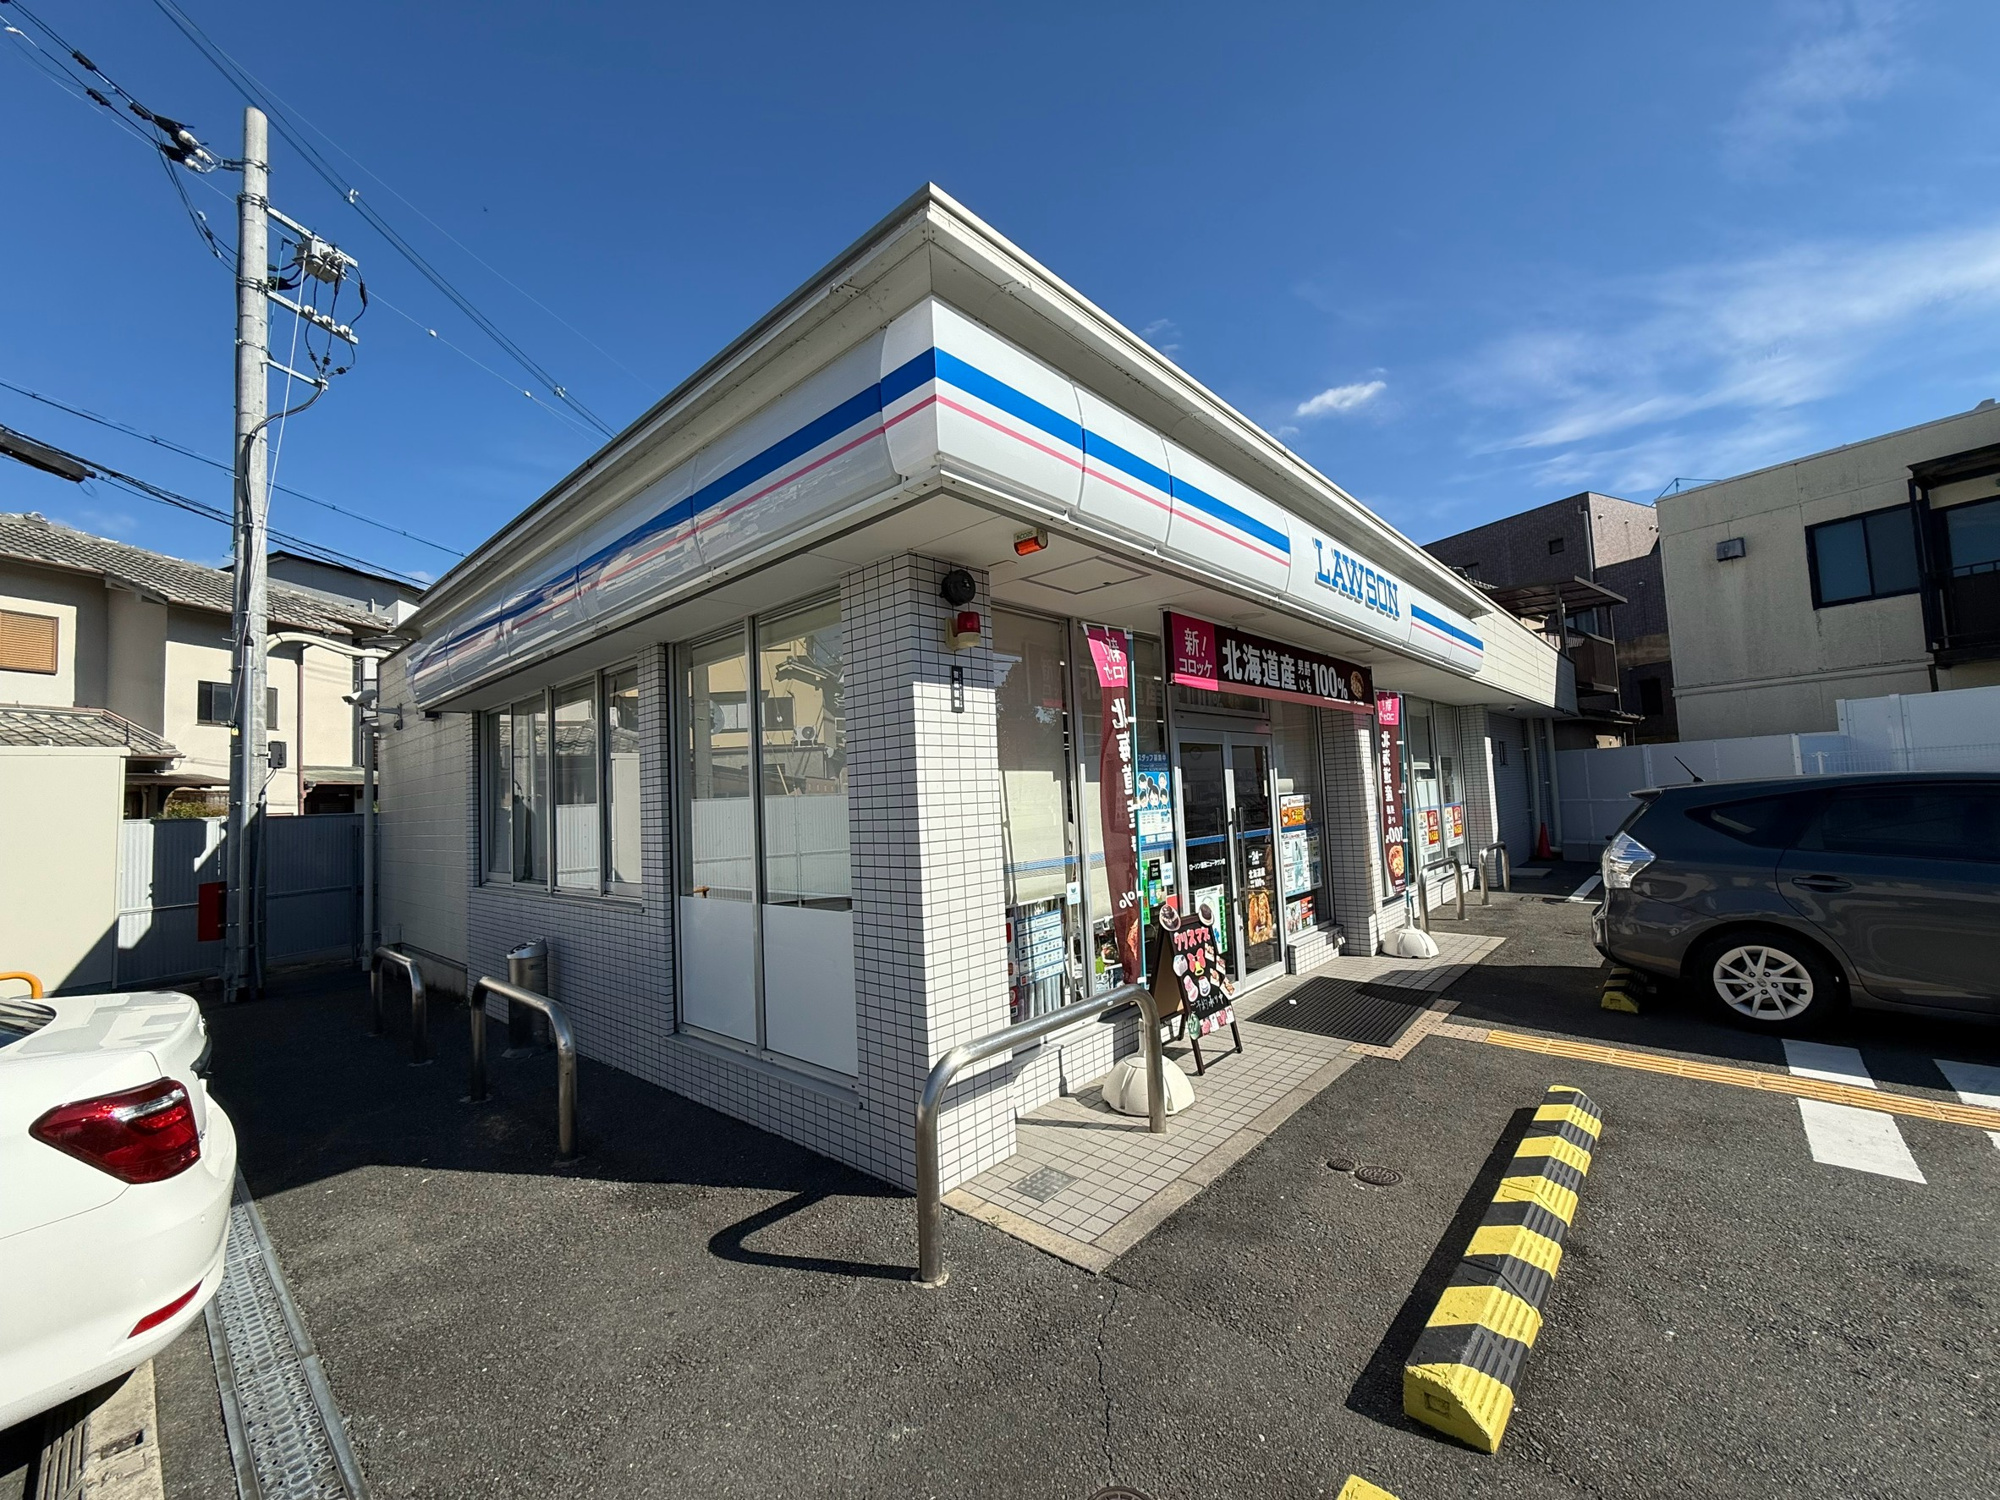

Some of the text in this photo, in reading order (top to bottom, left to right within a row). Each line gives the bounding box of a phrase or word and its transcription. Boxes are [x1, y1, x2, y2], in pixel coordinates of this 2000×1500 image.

[1314, 537, 1400, 618] LAWSON
[1184, 628, 1208, 658] 新!
[1178, 657, 1213, 678] コロッケ
[1221, 638, 1349, 700] 北海道産 100%
[1173, 926, 1211, 951] クリスマス
